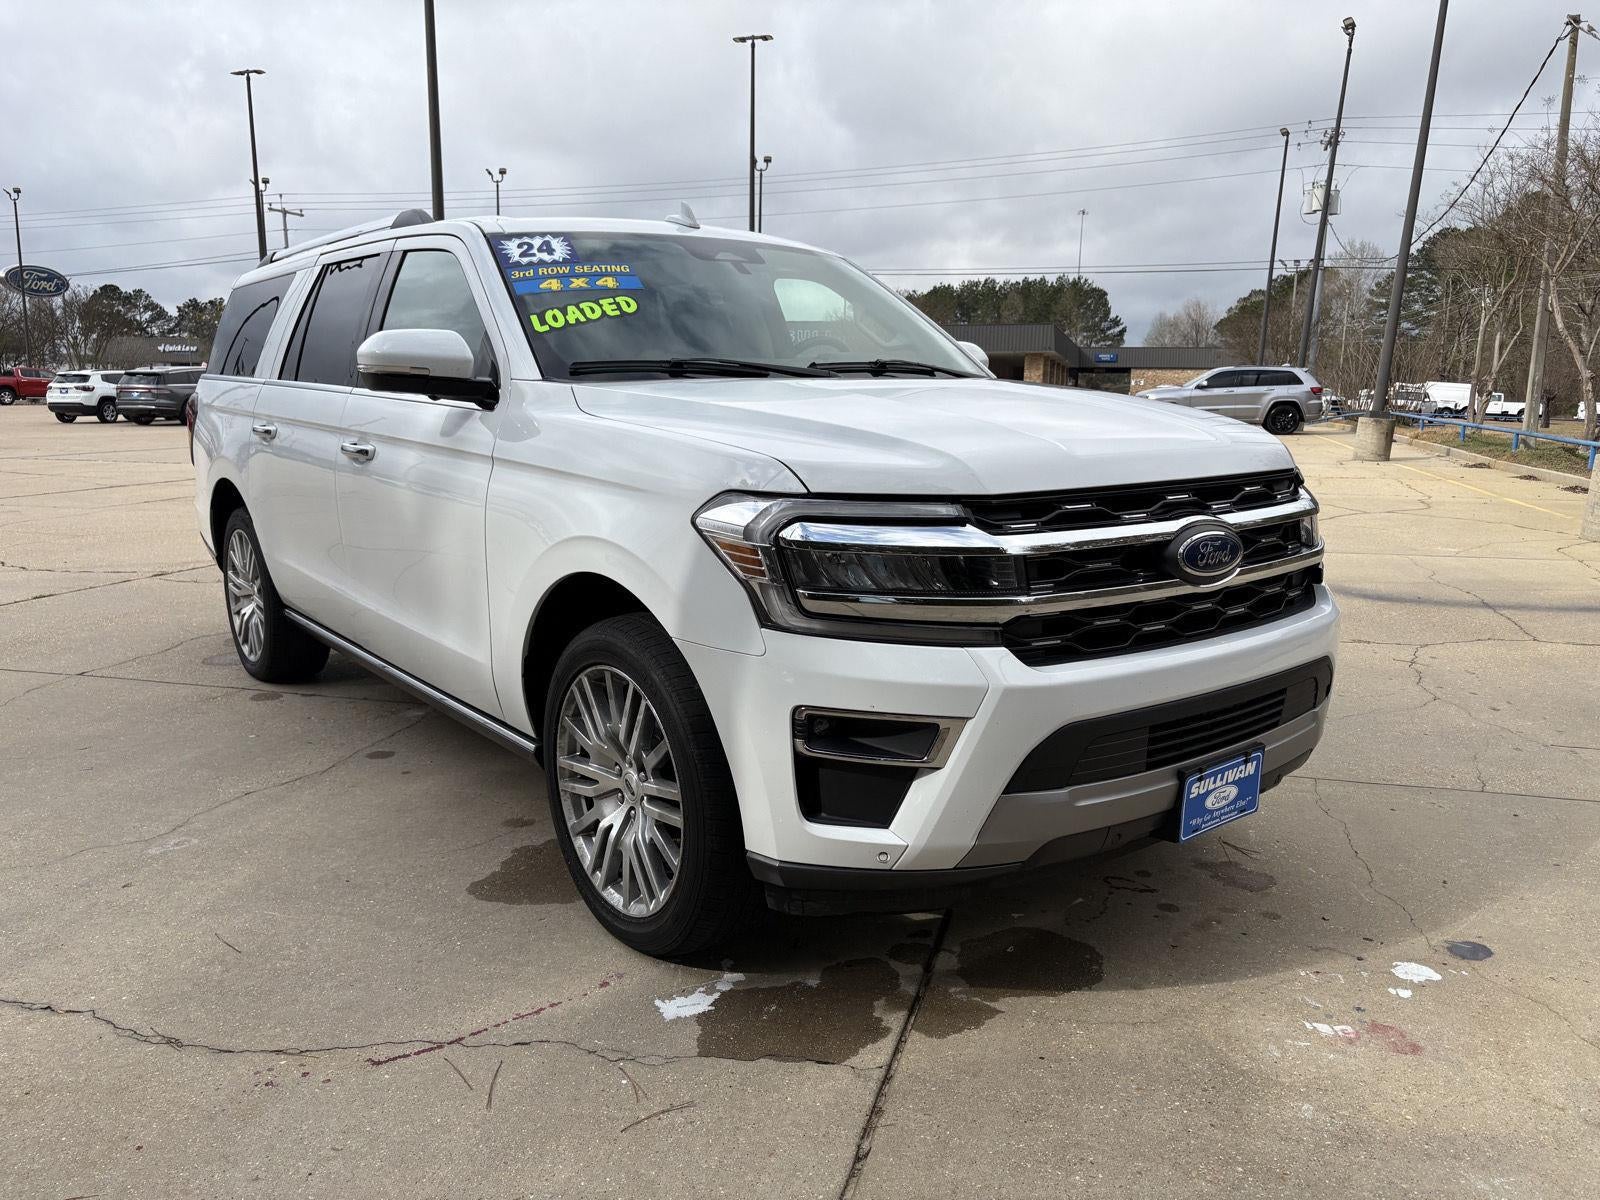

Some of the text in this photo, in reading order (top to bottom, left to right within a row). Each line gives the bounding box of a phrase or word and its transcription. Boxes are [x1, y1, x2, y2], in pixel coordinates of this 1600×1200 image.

[516, 240, 556, 259] 24
[23, 270, 59, 291] Ford
[511, 264, 631, 279] 3rd ROW SEATING
[530, 295, 638, 333] LOADED
[1197, 540, 1232, 567] Ford
[1189, 760, 1257, 799] SULLIVAN
[1211, 789, 1233, 807] Ford
